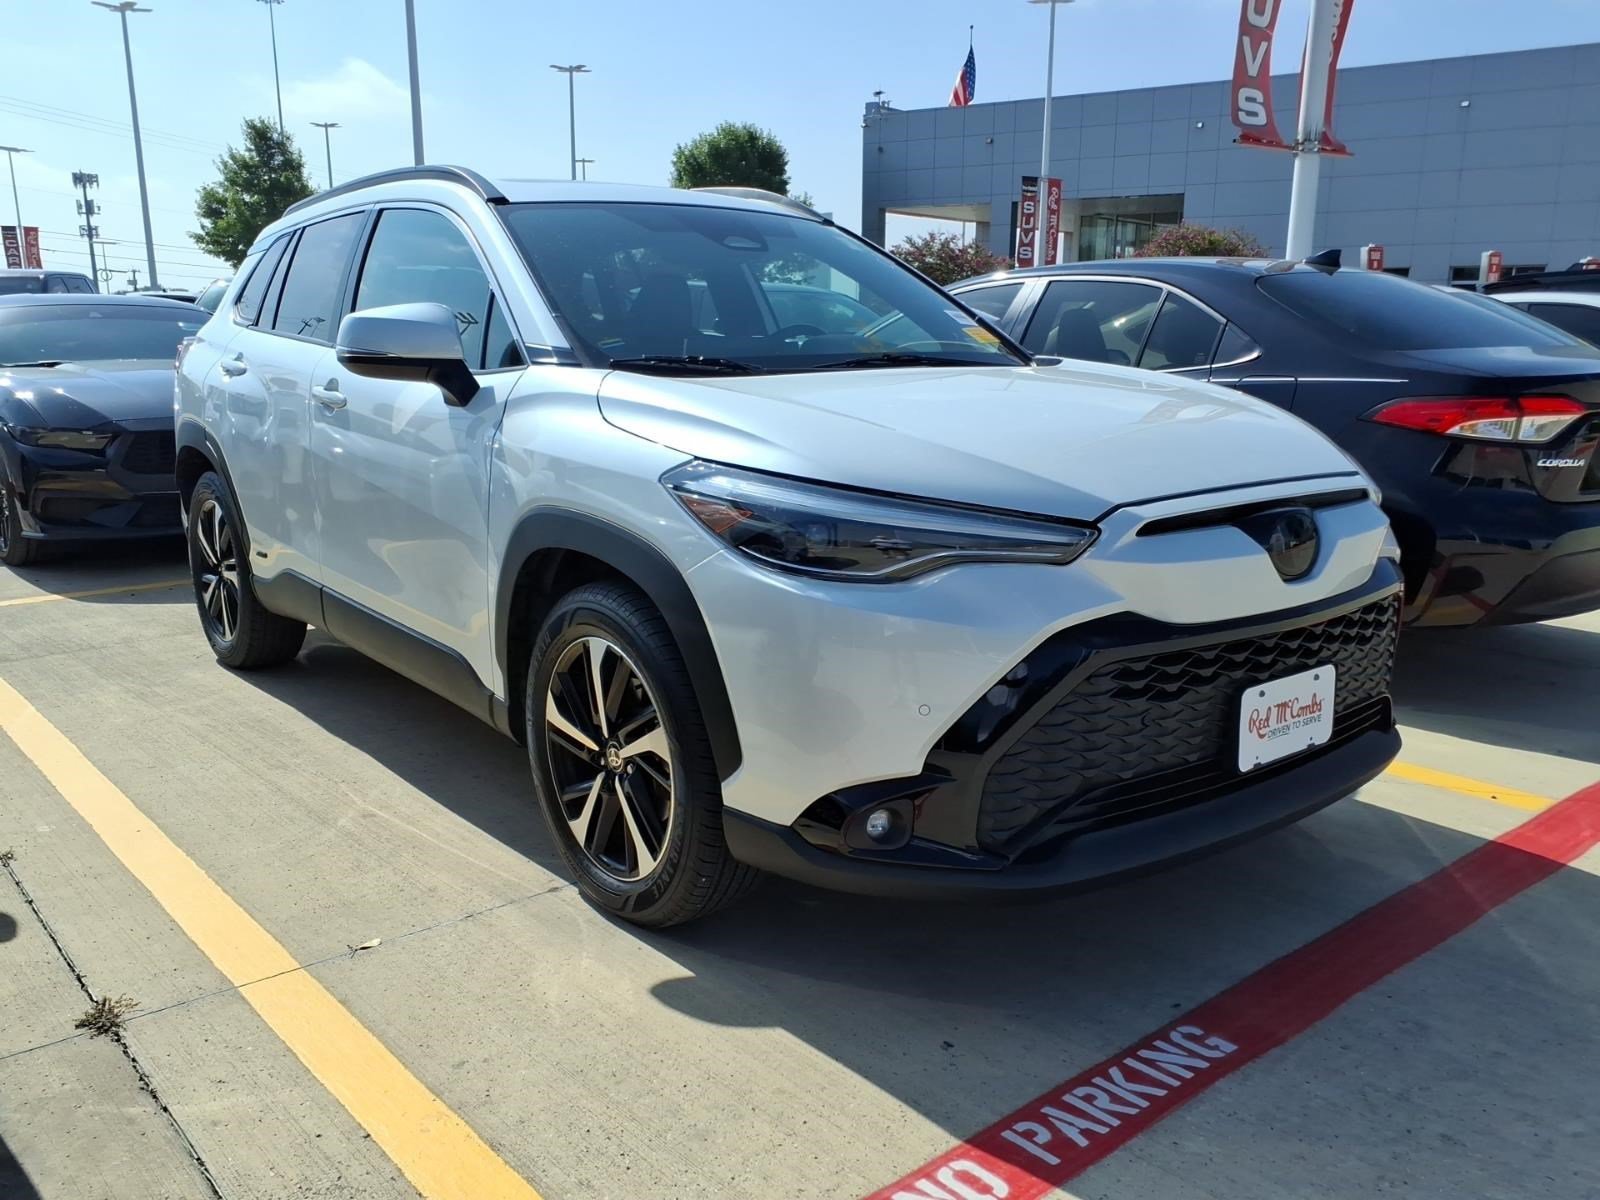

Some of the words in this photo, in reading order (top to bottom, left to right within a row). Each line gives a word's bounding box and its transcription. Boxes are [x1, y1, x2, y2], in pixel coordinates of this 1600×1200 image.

[1019, 201, 1035, 259] SUVS
[5, 239, 22, 269] CAR
[1536, 458, 1585, 467] COROLLA
[1248, 706, 1272, 739] Red
[1273, 692, 1323, 725] McCombs
[1267, 723, 1291, 739] DRIVEN
[1292, 719, 1301, 730] TO
[1301, 714, 1322, 727] SERVE
[1000, 1025, 1239, 1166] PARKING
